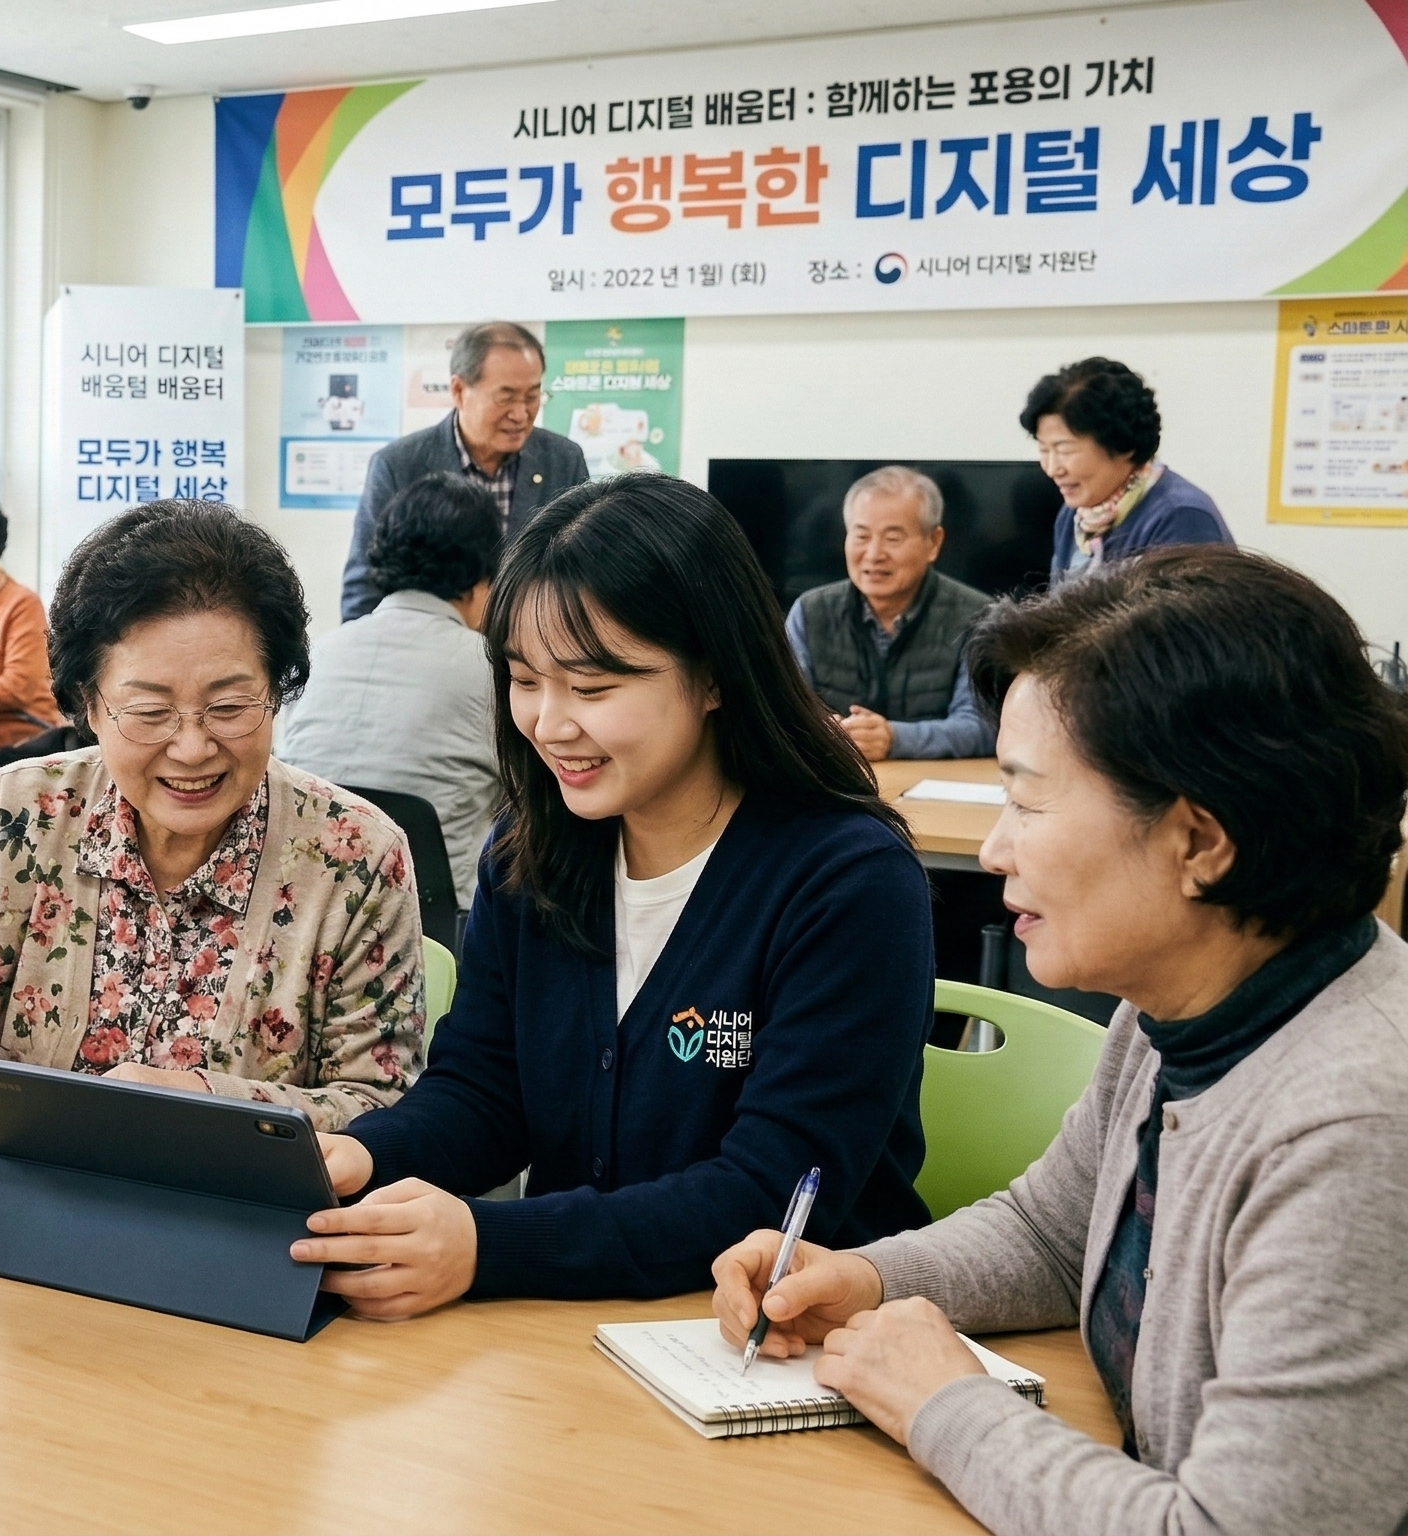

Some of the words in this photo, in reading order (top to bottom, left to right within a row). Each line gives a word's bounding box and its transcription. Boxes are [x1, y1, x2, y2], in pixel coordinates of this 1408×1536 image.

[514, 103, 595, 138] 시니어
[609, 95, 693, 132] 디지털
[705, 87, 795, 125] 배움터
[827, 75, 955, 118] 함께하는
[968, 64, 1070, 106] 포용의
[1086, 57, 1154, 96] 가치
[387, 162, 582, 241] 모두가
[606, 145, 828, 233] 행복한
[856, 127, 1100, 220] 디지털
[1132, 112, 1322, 205] 세상
[548, 270, 584, 292] 일시
[604, 268, 654, 288] 2022
[661, 266, 678, 288] 년
[732, 262, 766, 285] (회)
[809, 260, 849, 284] 장소
[917, 256, 970, 276] 시니어
[977, 254, 1031, 274] 디지털
[1039, 251, 1097, 272] 지원단
[82, 343, 147, 368] 시니어
[159, 345, 223, 369] 디지털
[82, 374, 147, 399] 배움털
[158, 376, 223, 400] 배움터
[78, 440, 162, 467] 모두가
[172, 440, 226, 467] 행복
[78, 475, 159, 503] 디지털
[173, 477, 228, 502] 세상
[709, 1010, 752, 1030] 시니어
[707, 1030, 752, 1049] 디지털
[705, 1049, 752, 1068] 지원단
